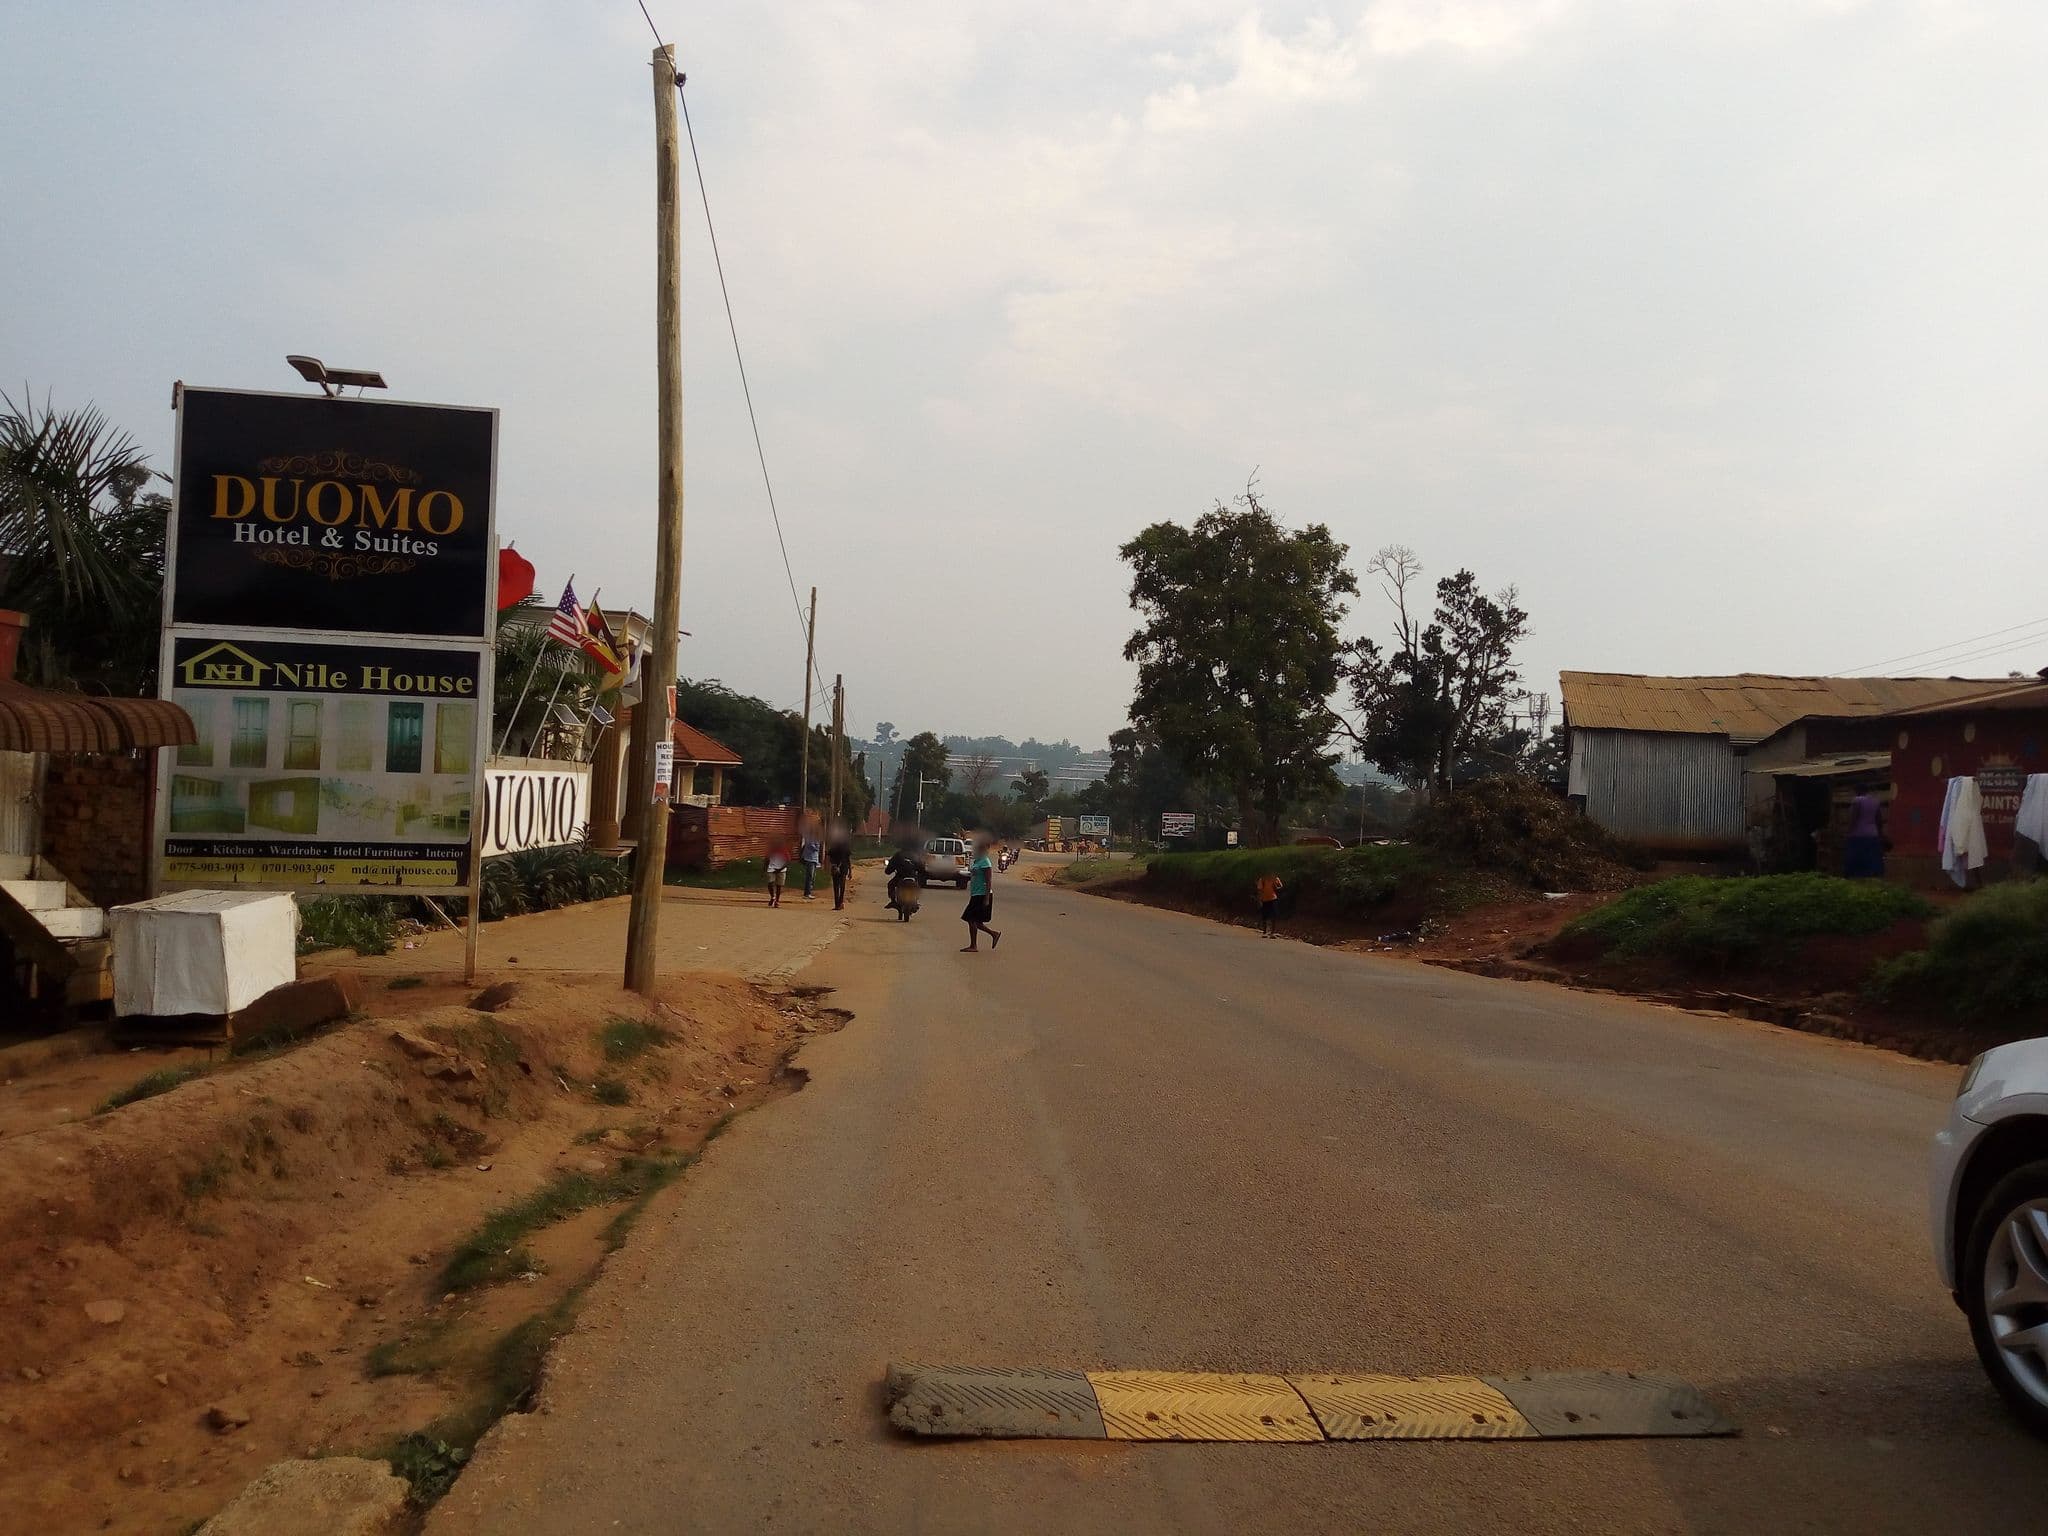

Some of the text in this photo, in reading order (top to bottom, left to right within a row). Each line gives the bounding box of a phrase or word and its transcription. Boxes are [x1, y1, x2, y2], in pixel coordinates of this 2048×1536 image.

[210, 474, 465, 536] DUOMO
[232, 522, 439, 556] Hotel & Suites
[203, 663, 246, 681] NH
[272, 662, 474, 694] Nile House
[1982, 795, 2019, 810] AINTS
[167, 844, 193, 854] Door
[213, 844, 254, 855] Kitchen
[269, 845, 322, 857] Wardrobe
[333, 846, 363, 857] Hotel
[364, 847, 414, 858] Furniture
